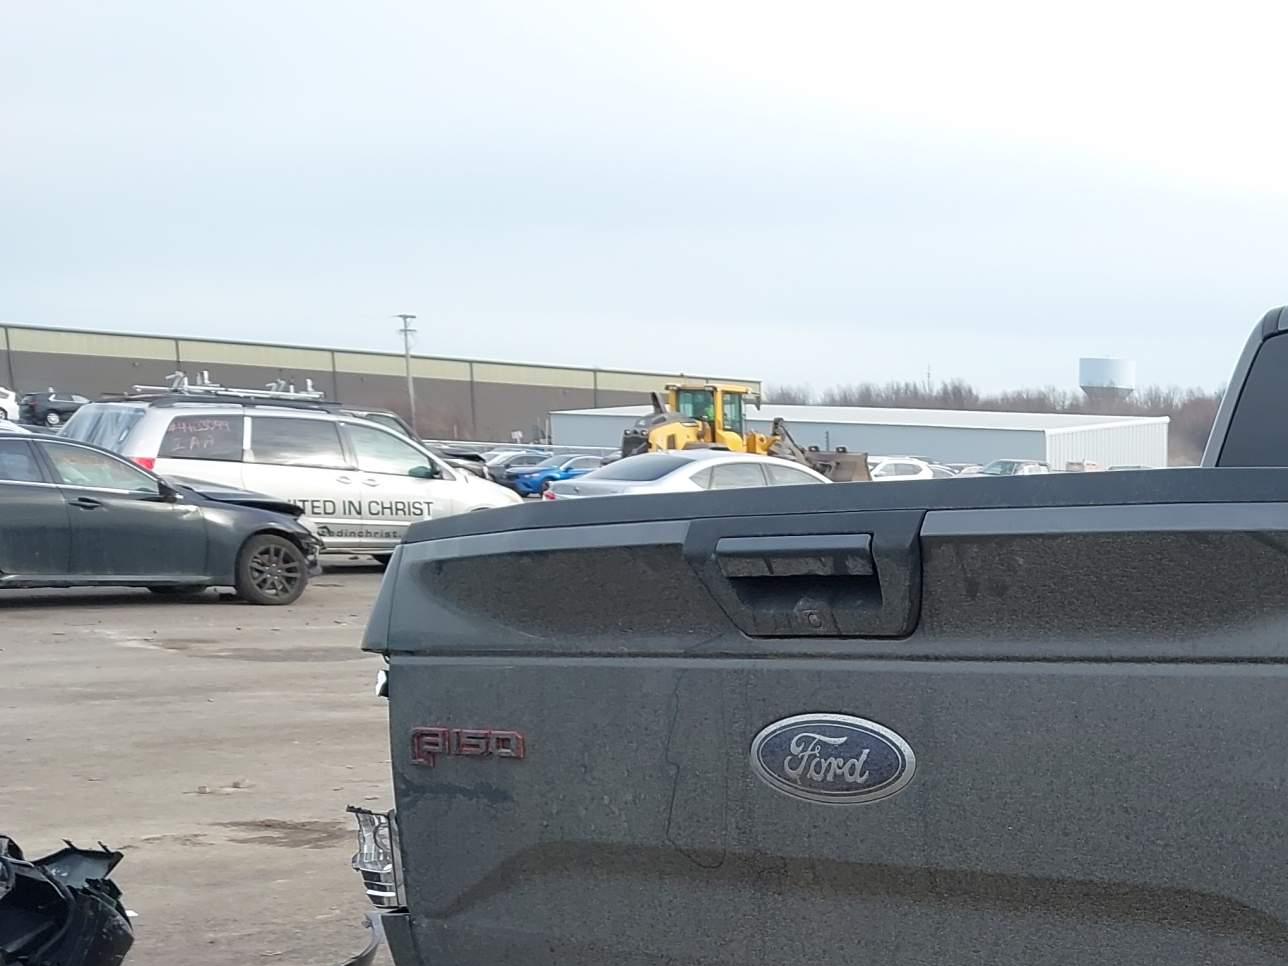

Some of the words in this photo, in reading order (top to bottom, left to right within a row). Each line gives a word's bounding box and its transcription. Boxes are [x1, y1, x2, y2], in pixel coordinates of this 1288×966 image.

[342, 500, 362, 516] IN
[367, 500, 434, 517] CHRIST
[784, 732, 870, 784] Ford
